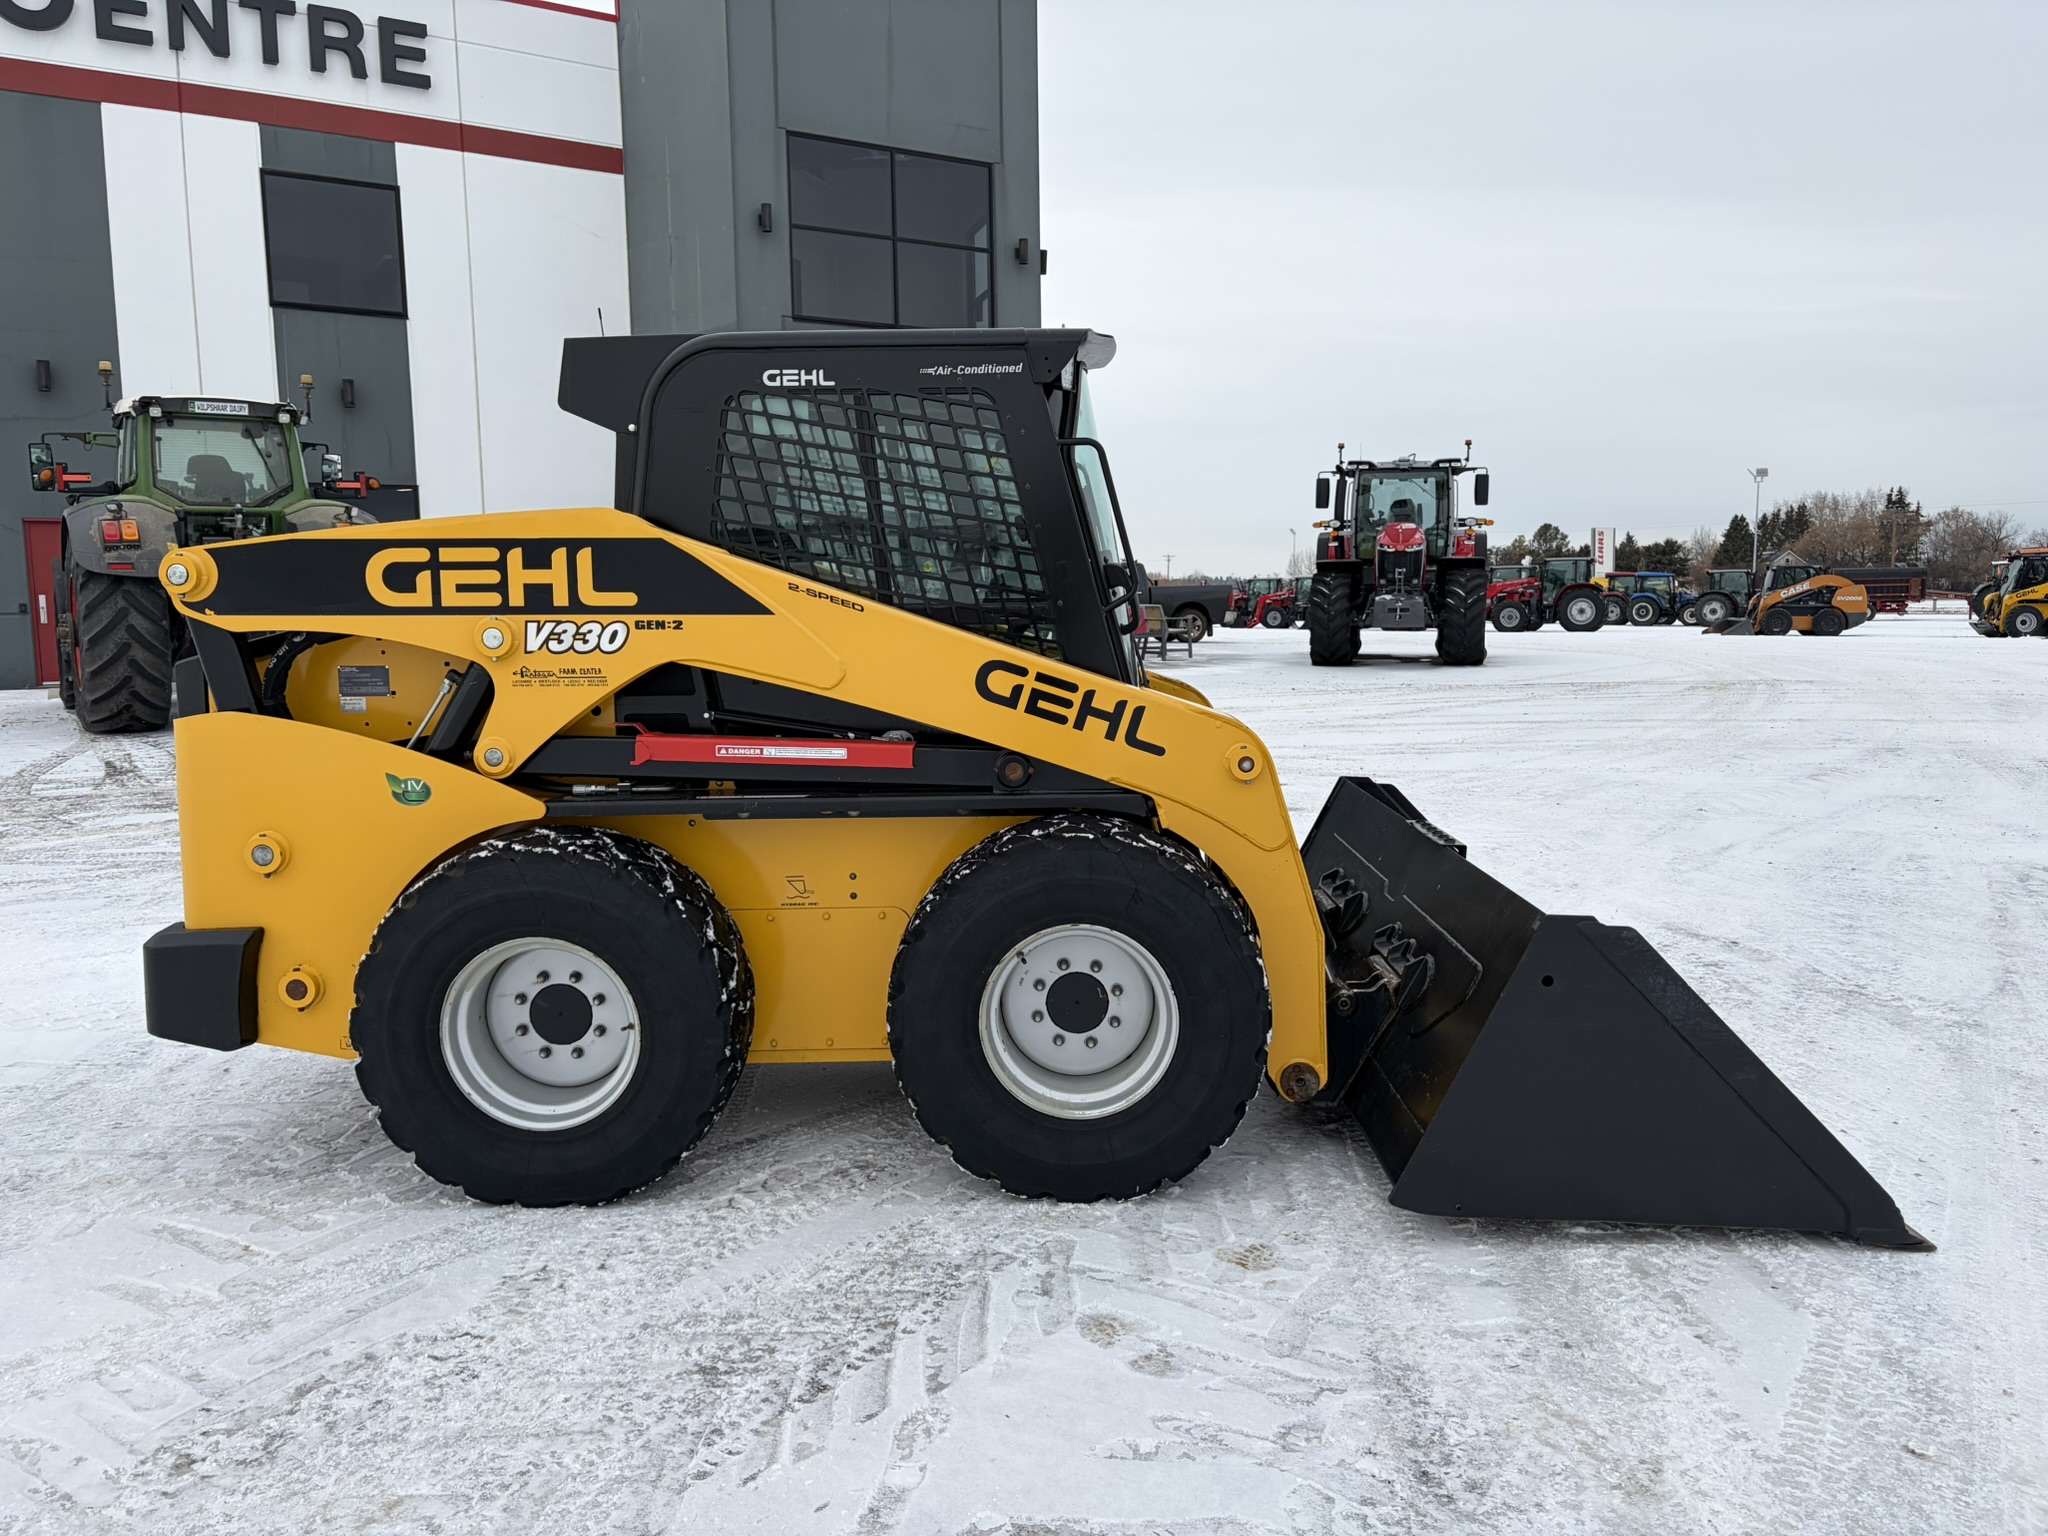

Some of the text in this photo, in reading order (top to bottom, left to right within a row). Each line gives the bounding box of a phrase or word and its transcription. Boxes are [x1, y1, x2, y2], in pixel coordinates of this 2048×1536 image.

[762, 369, 836, 387] GEHL
[935, 363, 1023, 376] Air-Conditioned
[365, 547, 639, 608] GEHL
[788, 582, 865, 613] 2-SPEED
[1780, 581, 1811, 598] CASE
[2015, 588, 2039, 599] GEHL
[524, 620, 684, 655] V330 GEN:2
[974, 659, 1167, 757] GEHL
[728, 747, 761, 755] DANGER
